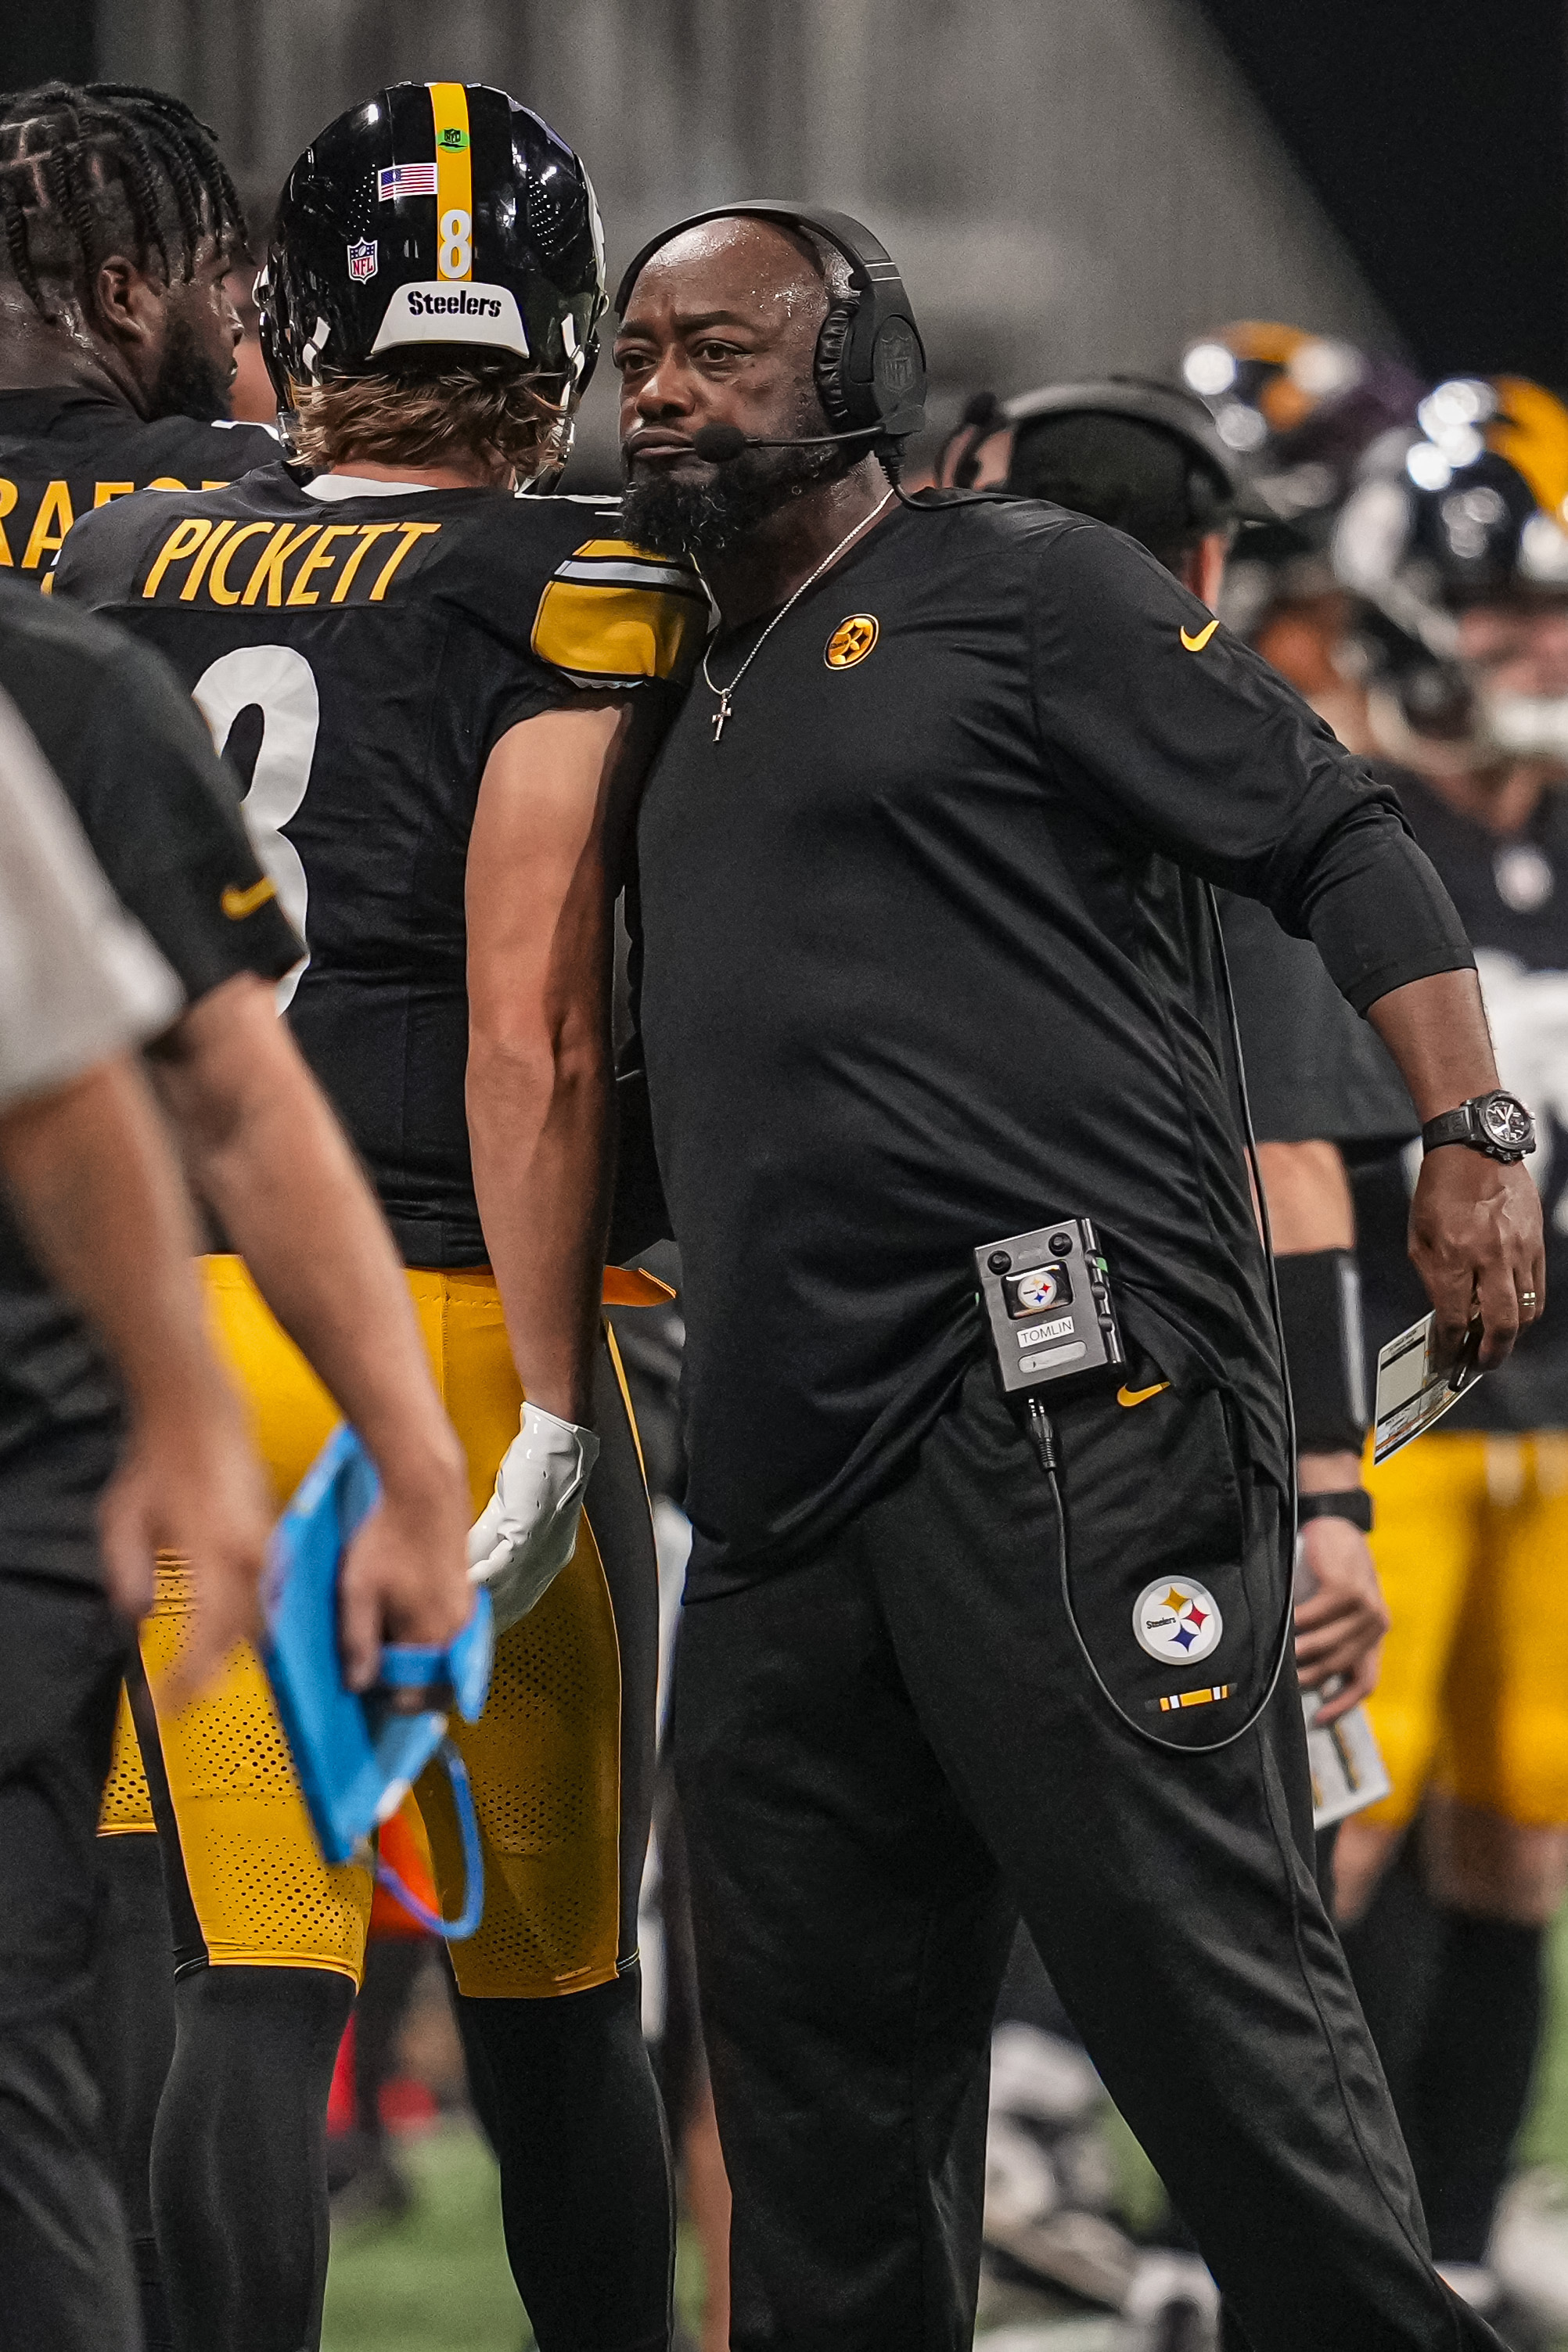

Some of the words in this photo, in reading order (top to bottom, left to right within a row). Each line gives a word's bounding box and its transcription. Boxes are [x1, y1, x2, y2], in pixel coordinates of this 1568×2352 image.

[439, 209, 471, 279] 8
[353, 257, 374, 275] NFL
[407, 290, 502, 318] Steelers
[142, 519, 441, 606] PICKETT
[1021, 1320, 1072, 1343] TOMLIN
